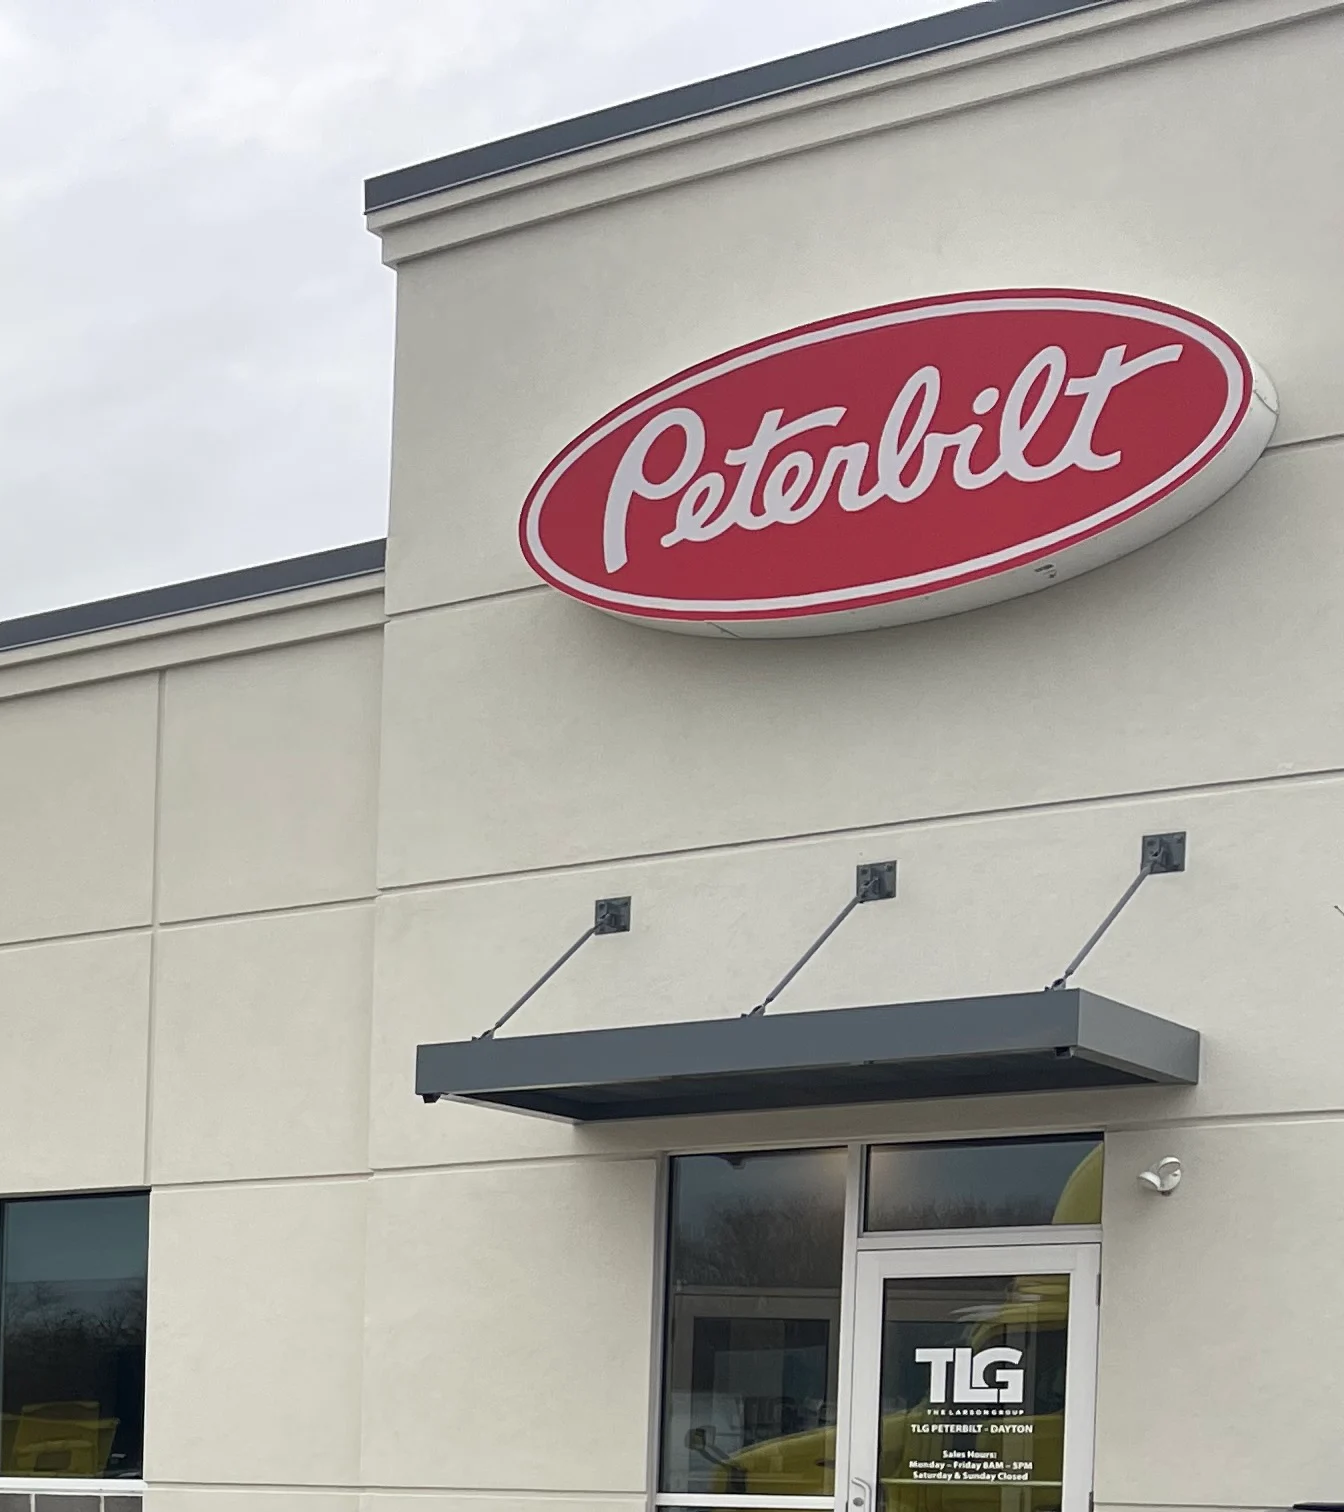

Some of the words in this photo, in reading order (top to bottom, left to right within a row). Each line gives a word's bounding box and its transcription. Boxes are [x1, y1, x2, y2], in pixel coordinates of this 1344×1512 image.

[602, 343, 1184, 574] Peterbilt
[915, 1347, 1024, 1403] TLG
[911, 1424, 929, 1433] TLG
[931, 1424, 983, 1434] PETERBILT
[990, 1424, 1034, 1434] DAYTON
[942, 1450, 966, 1459] Sales
[967, 1450, 997, 1459] Hours:
[909, 1461, 945, 1470] Monday
[953, 1461, 981, 1471] Friday
[982, 1461, 1004, 1470] 8AM
[1012, 1462, 1033, 1470] 5PM
[913, 1471, 952, 1481] Saturday
[962, 1472, 996, 1482] Sunday
[997, 1472, 1029, 1481] Closed
